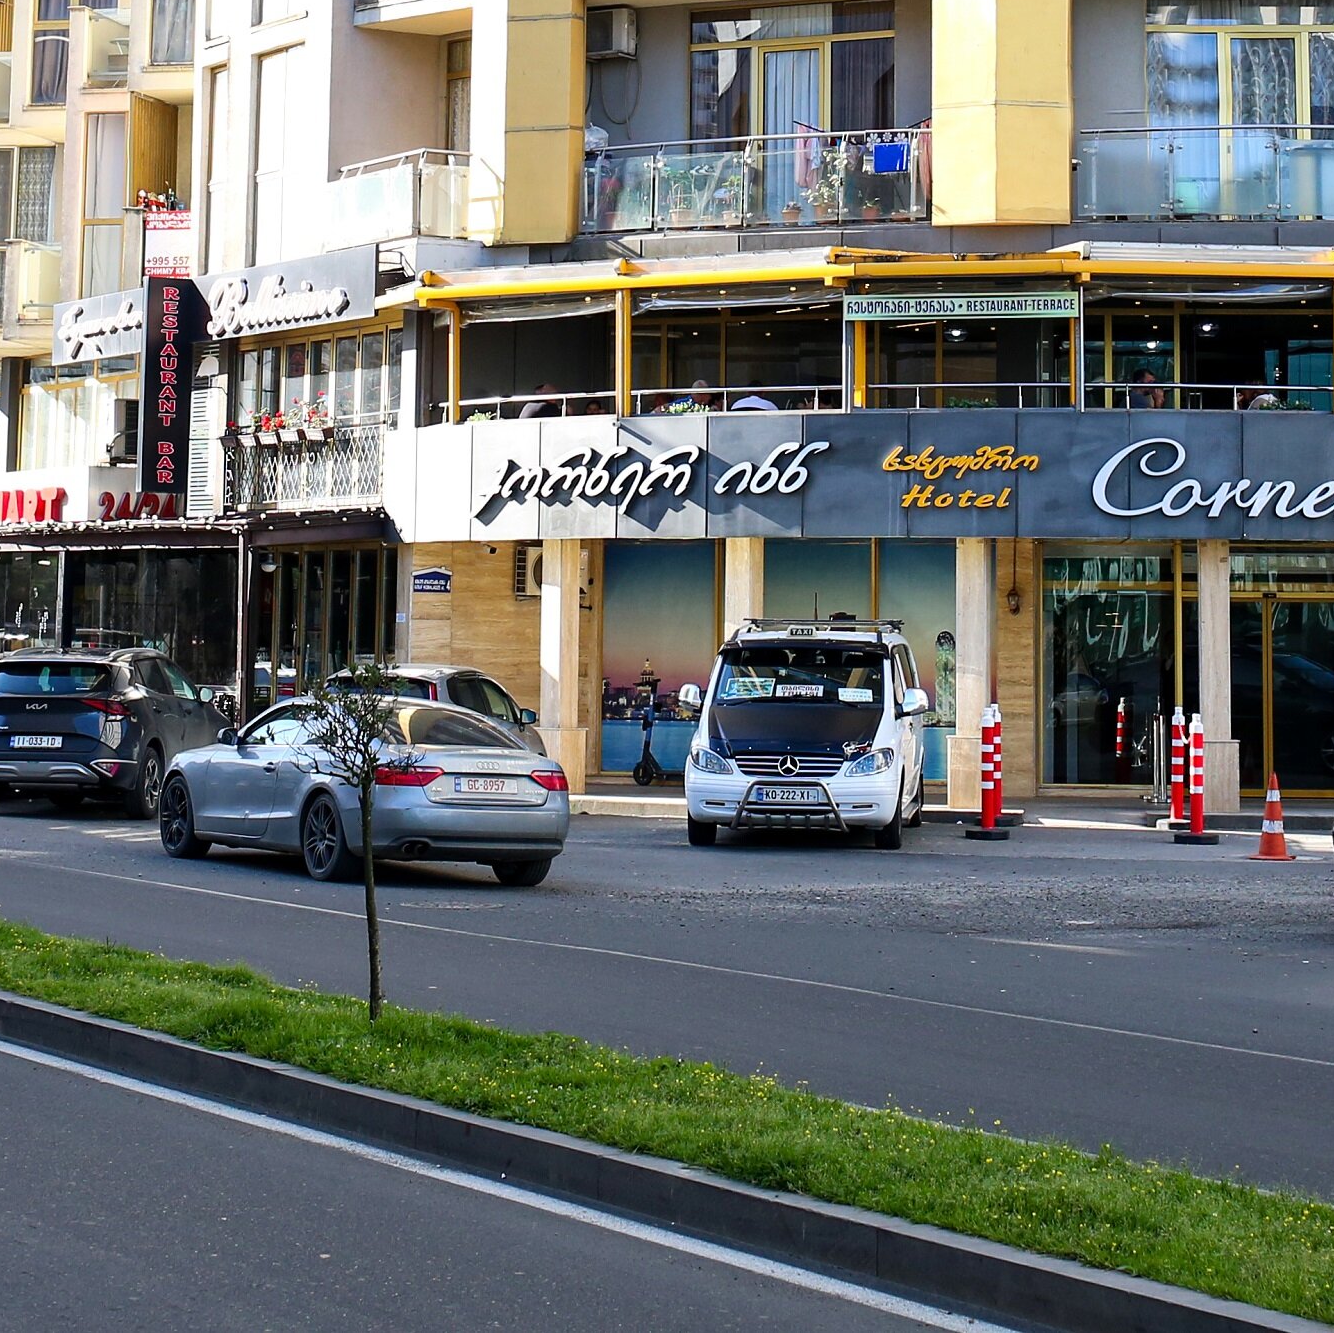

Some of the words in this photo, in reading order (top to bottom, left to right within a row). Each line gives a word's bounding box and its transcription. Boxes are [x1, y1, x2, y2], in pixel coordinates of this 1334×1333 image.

[146, 256, 170, 266] +995
[172, 256, 190, 266] 557
[145, 267, 174, 275] СНИМУ
[966, 298, 1075, 312] RESTAURANT-TERRACE
[158, 286, 180, 426] RESTAURANT
[156, 442, 175, 483] BAR
[715, 441, 830, 495] ინნ
[882, 445, 1040, 480] სასტუმრო
[901, 484, 1012, 508] Hotel
[792, 628, 813, 636] TAXI
[17, 736, 56, 746] II-033-ID
[467, 779, 506, 792] GC-8957
[765, 789, 810, 800] KO-222-XI
